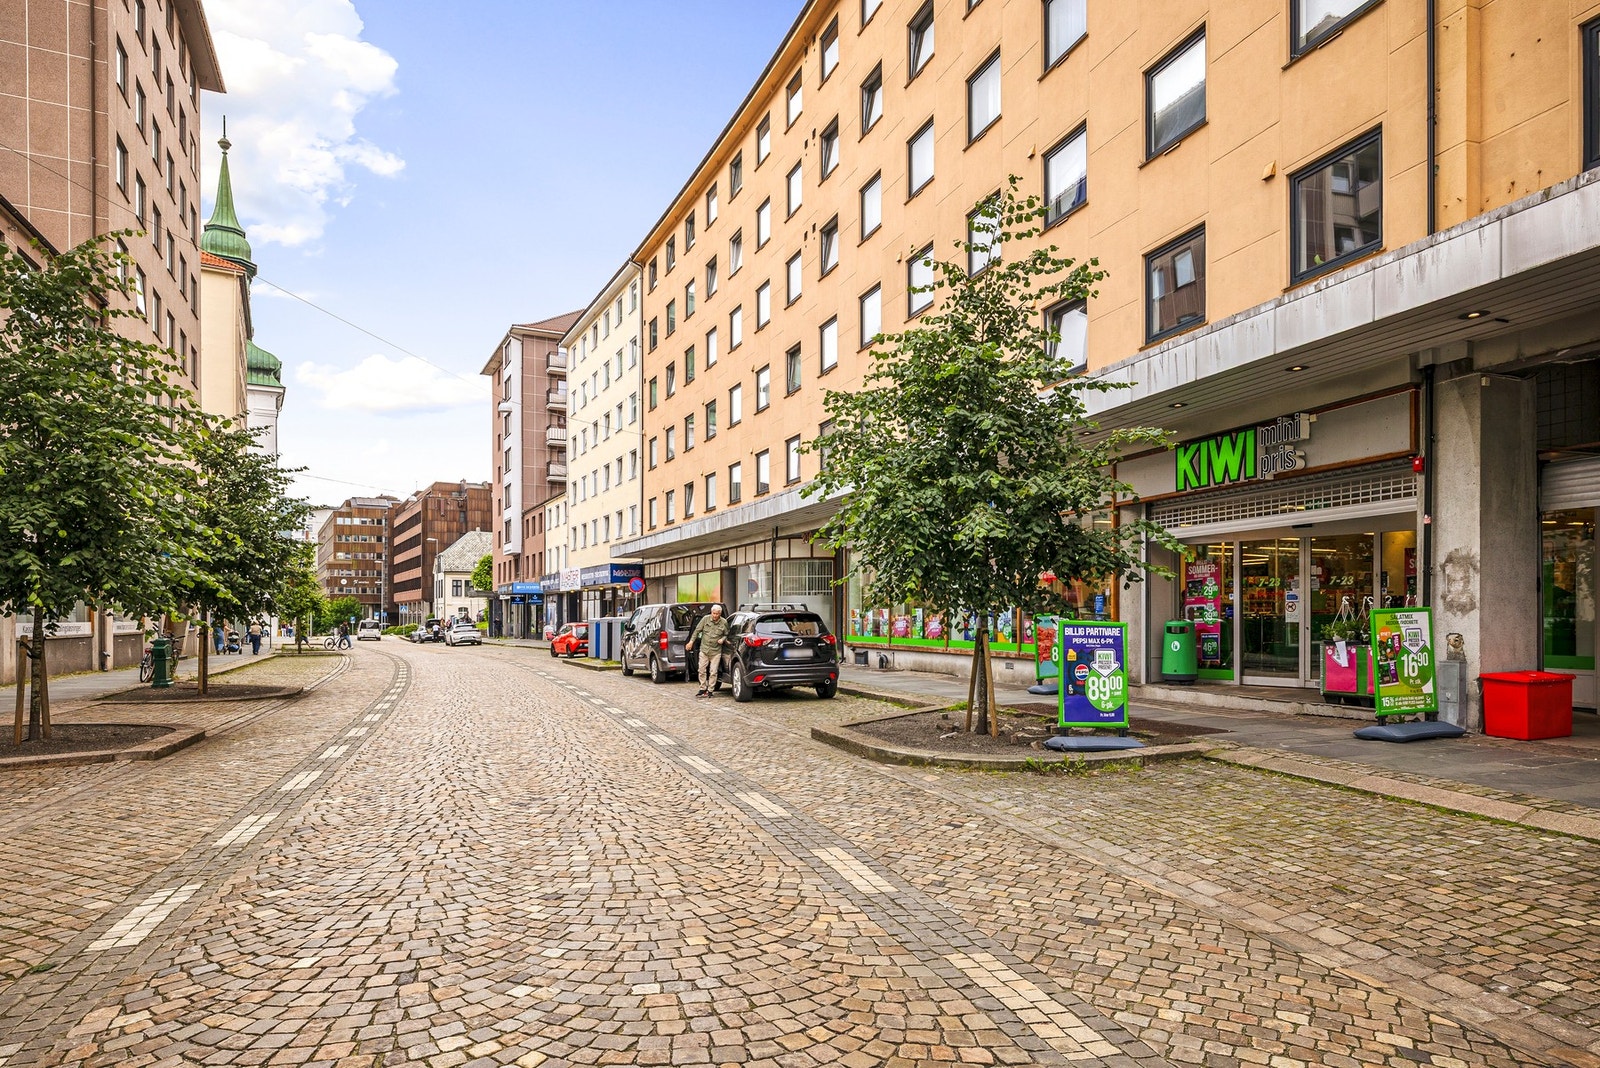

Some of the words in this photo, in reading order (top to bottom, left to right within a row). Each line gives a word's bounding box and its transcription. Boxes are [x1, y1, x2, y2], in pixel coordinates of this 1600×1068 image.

[1259, 412, 1301, 446] mini
[1176, 428, 1256, 491] KIWI
[1259, 445, 1297, 480] pris
[1258, 577, 1281, 587] 7-23
[1329, 575, 1354, 585] 7-23
[1065, 627, 1084, 635] BILLIG
[1086, 627, 1120, 636] PARTIVARE
[1098, 652, 1112, 660] KIWI
